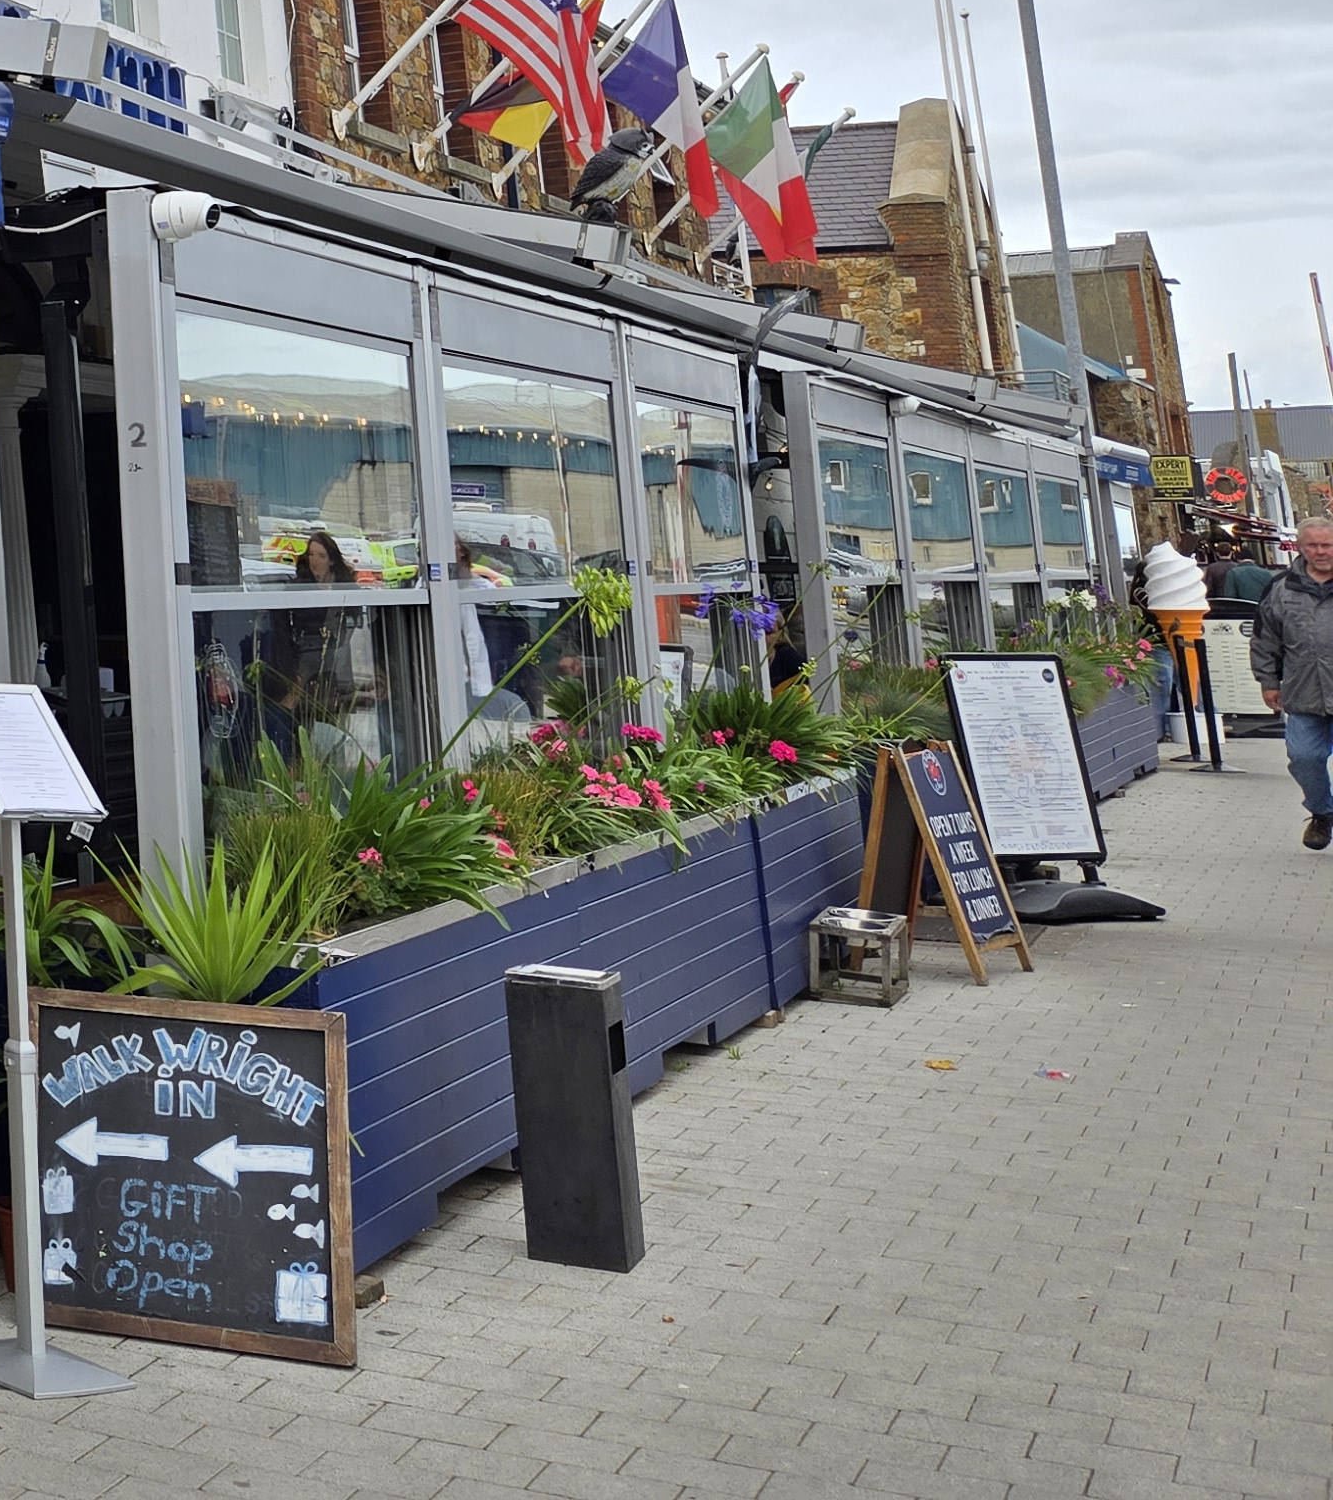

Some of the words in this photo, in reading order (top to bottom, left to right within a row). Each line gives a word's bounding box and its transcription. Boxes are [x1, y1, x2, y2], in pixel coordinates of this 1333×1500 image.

[128, 422, 148, 448] 2
[1155, 460, 1184, 470] EXPERT
[929, 813, 952, 838] OPEN
[954, 811, 977, 835] DAYS
[948, 843, 959, 865] A
[956, 840, 980, 864] WEEK
[951, 870, 971, 895] FOR
[966, 866, 996, 892] LUNCH
[965, 899, 977, 923] &
[971, 894, 1004, 921] DINNER
[42, 1032, 154, 1108] WALK
[111, 1219, 213, 1275] Shop
[105, 1259, 213, 1309] Open
